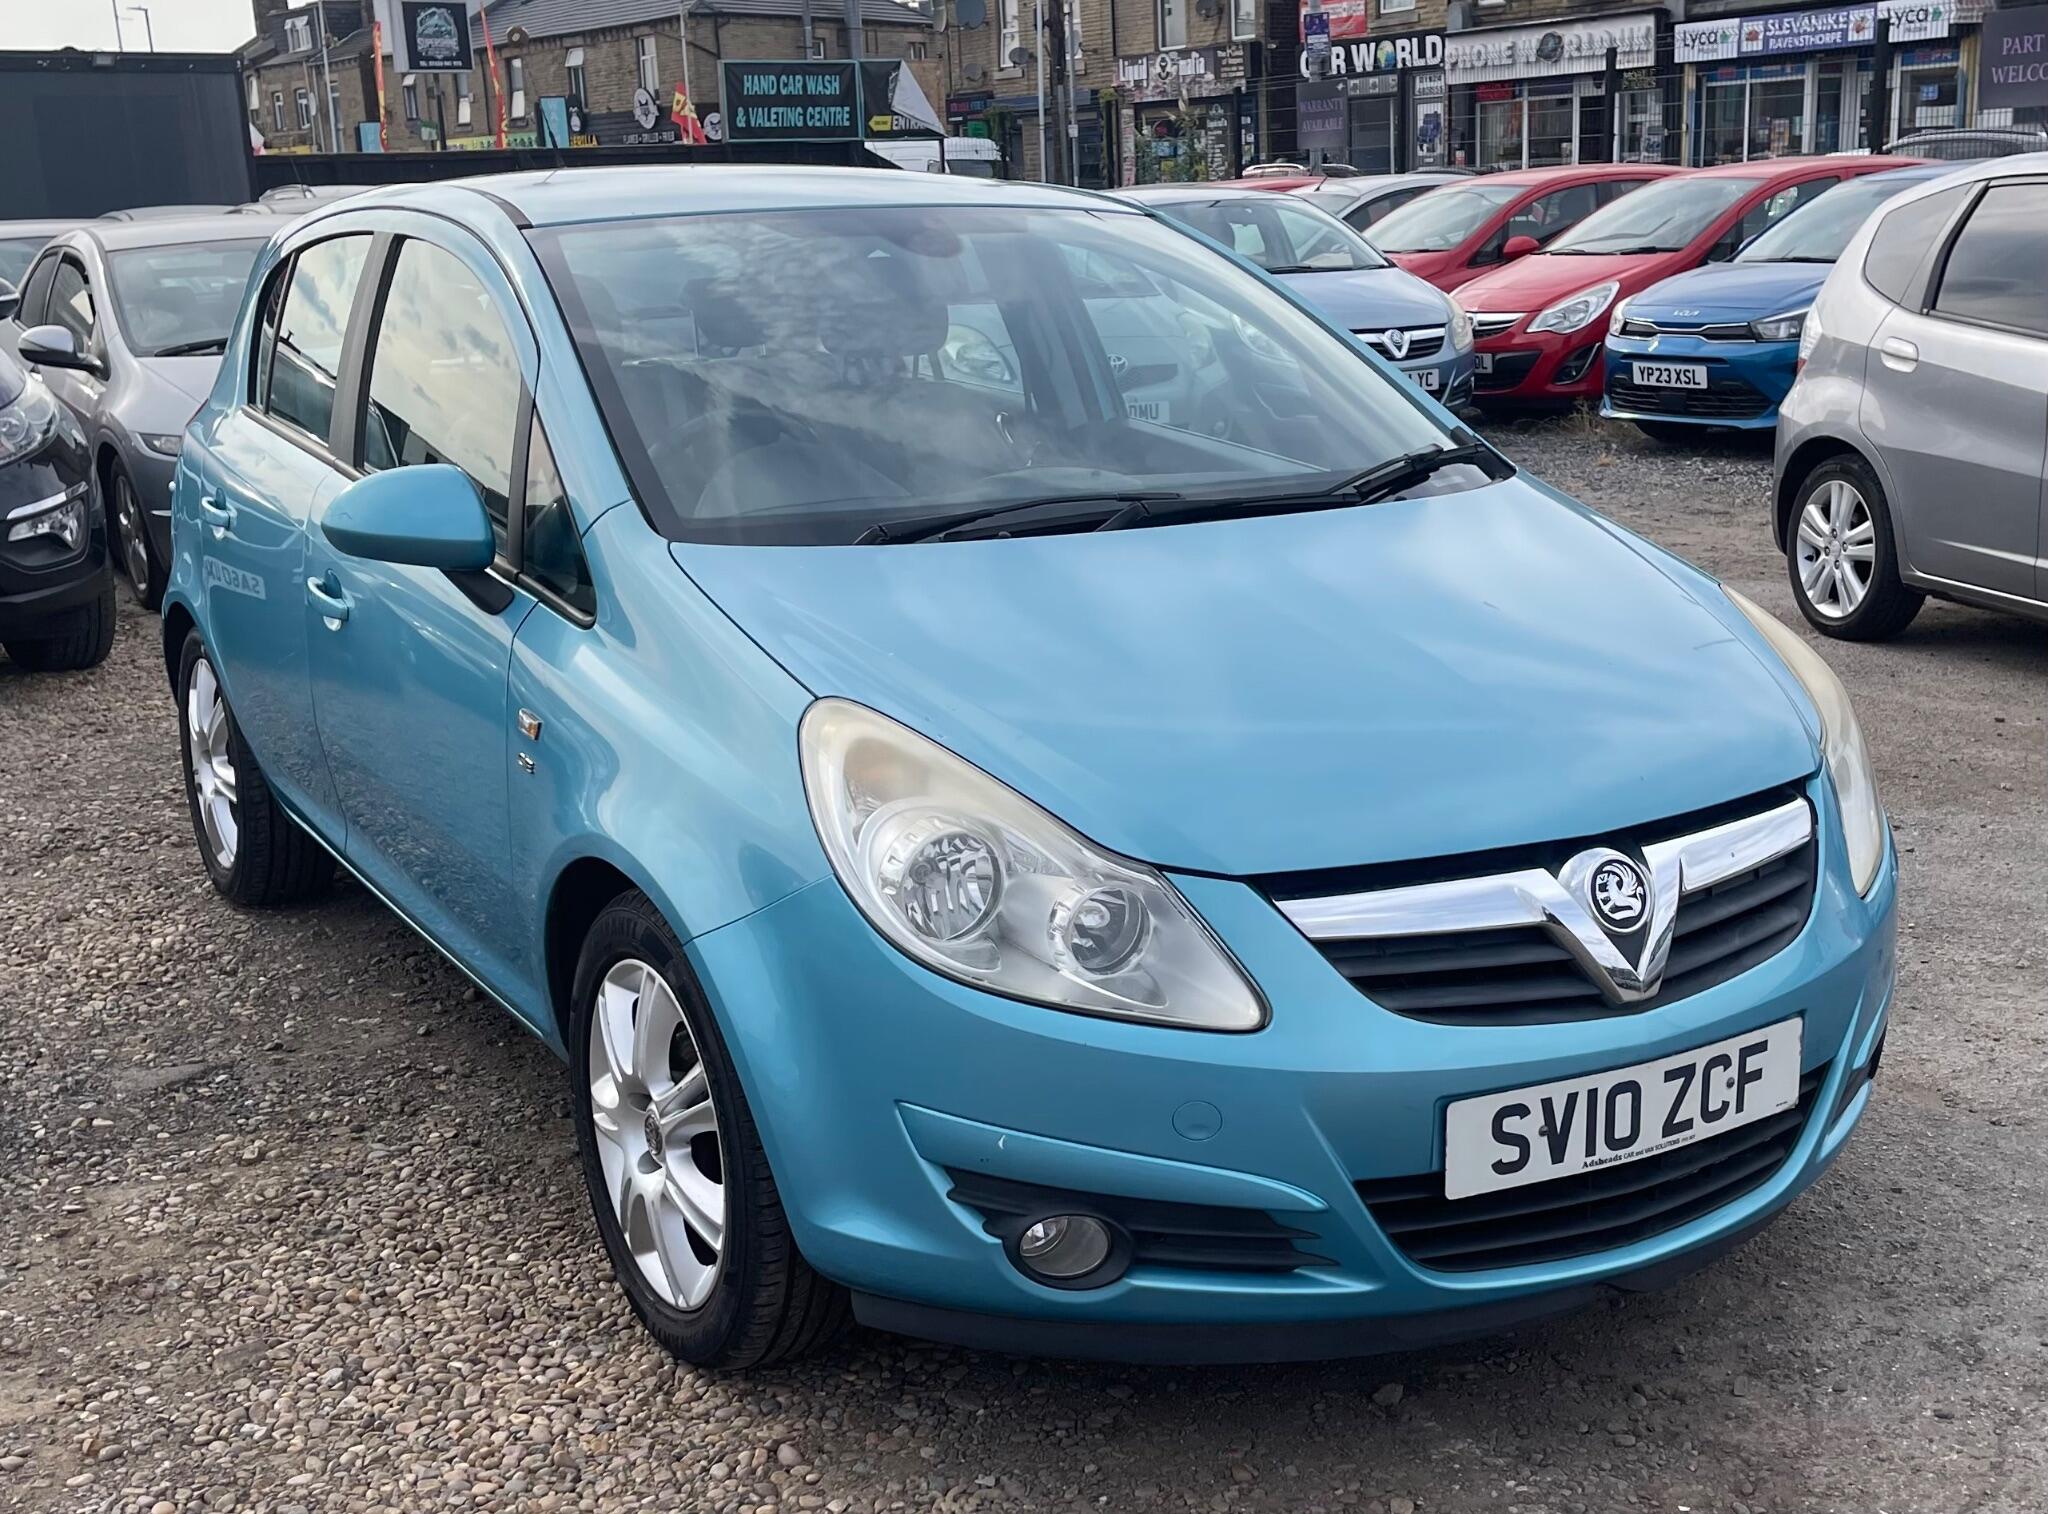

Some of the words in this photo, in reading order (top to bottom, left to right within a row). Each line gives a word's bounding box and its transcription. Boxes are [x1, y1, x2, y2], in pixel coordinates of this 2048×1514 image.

[1888, 8, 1929, 29] Lyca
[1683, 30, 1718, 48] Lyca
[1769, 32, 1842, 49] RAVENSTHORPE
[2002, 34, 2045, 55] PART
[1300, 45, 1346, 78] CR
[743, 75, 777, 95] HAND
[779, 75, 803, 95] CAR
[805, 75, 840, 95] WASH
[736, 107, 746, 127] &
[749, 107, 803, 128] VALETING
[806, 106, 850, 127] CENTRE
[1639, 366, 1671, 384] YP23
[1675, 368, 1701, 386] XSL
[1491, 1080, 1642, 1175] SV10
[1662, 1040, 1768, 1138] ZCF
[1582, 1154, 1623, 1169] Adsheads
[1623, 1151, 1635, 1160] CAR
